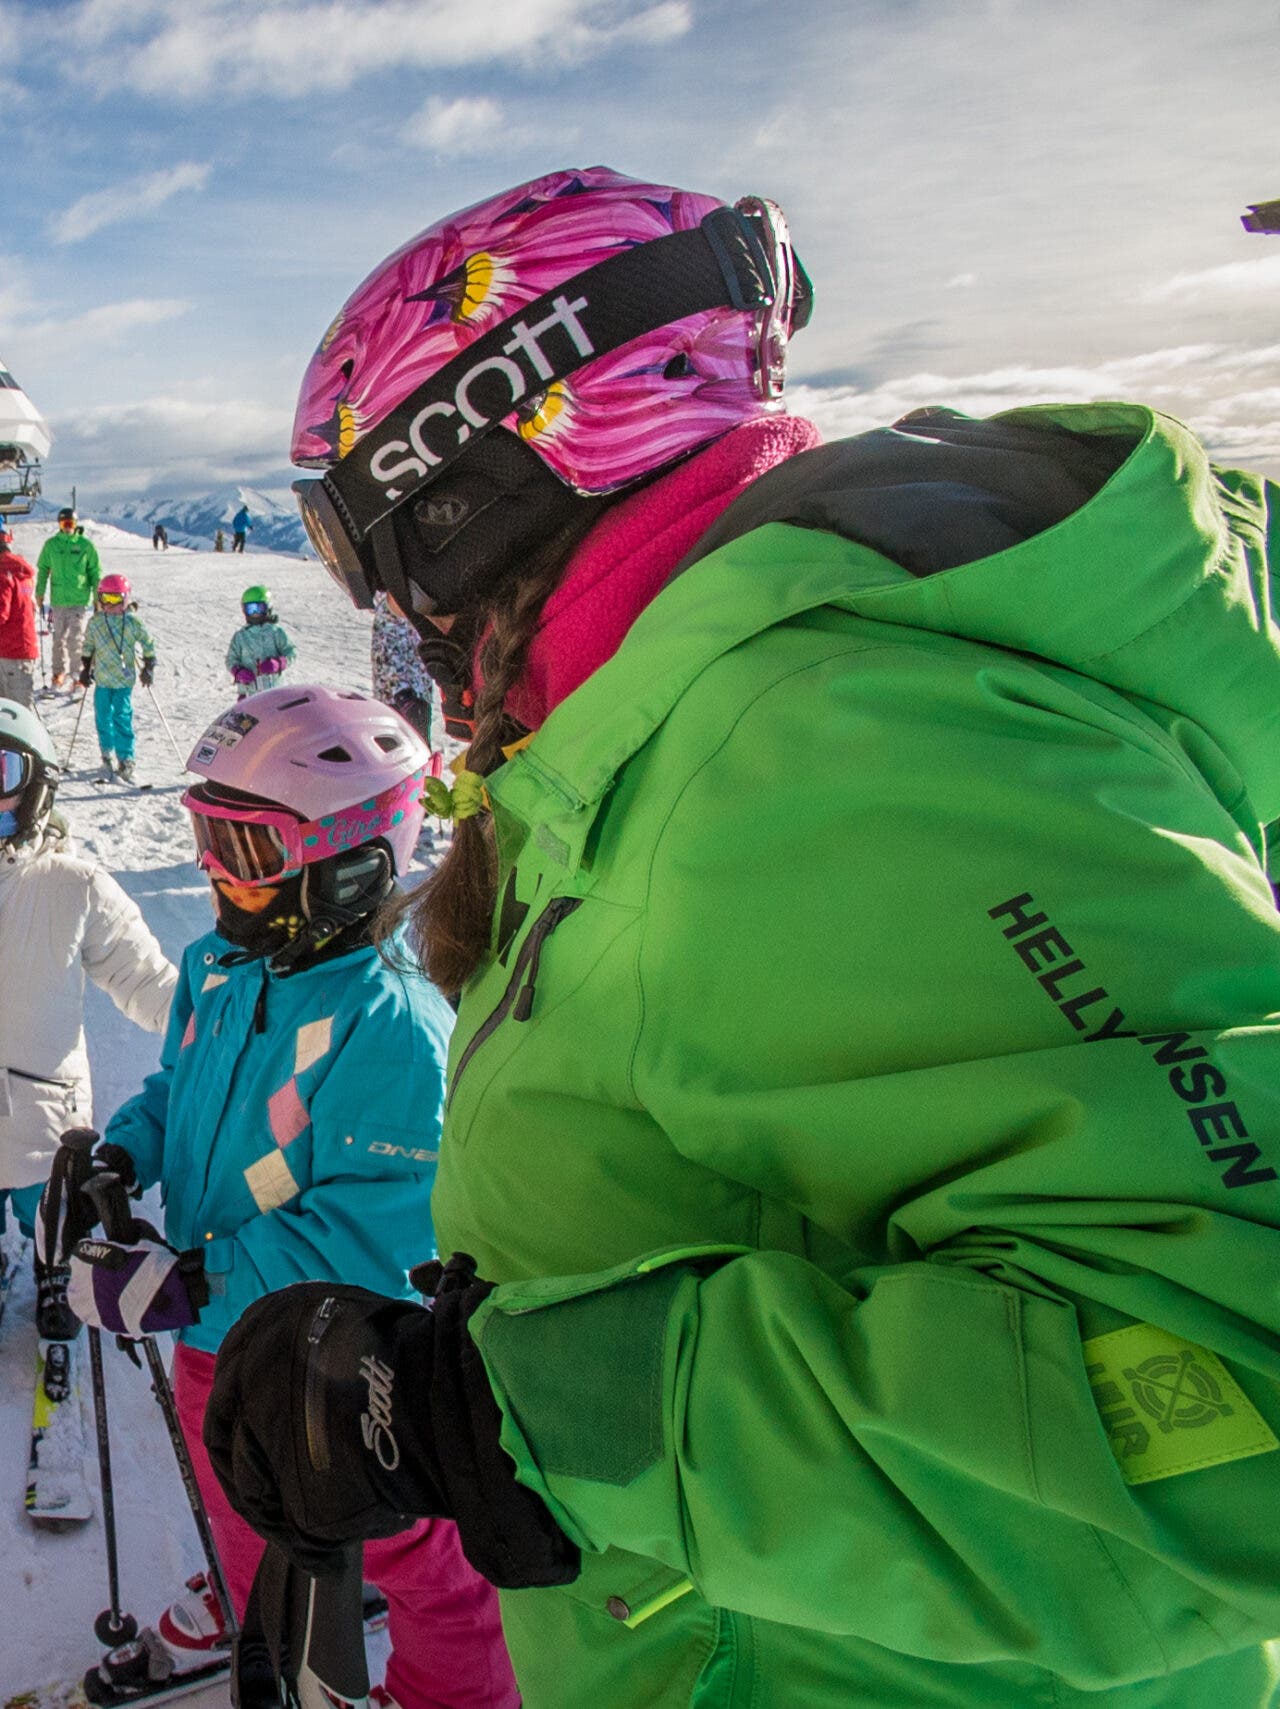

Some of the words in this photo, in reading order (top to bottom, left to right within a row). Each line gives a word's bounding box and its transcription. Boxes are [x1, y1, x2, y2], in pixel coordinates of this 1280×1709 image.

[987, 892, 1138, 1043] HELLY
[1137, 1032, 1279, 1189] NSEN
[359, 1354, 400, 1471] Scott
